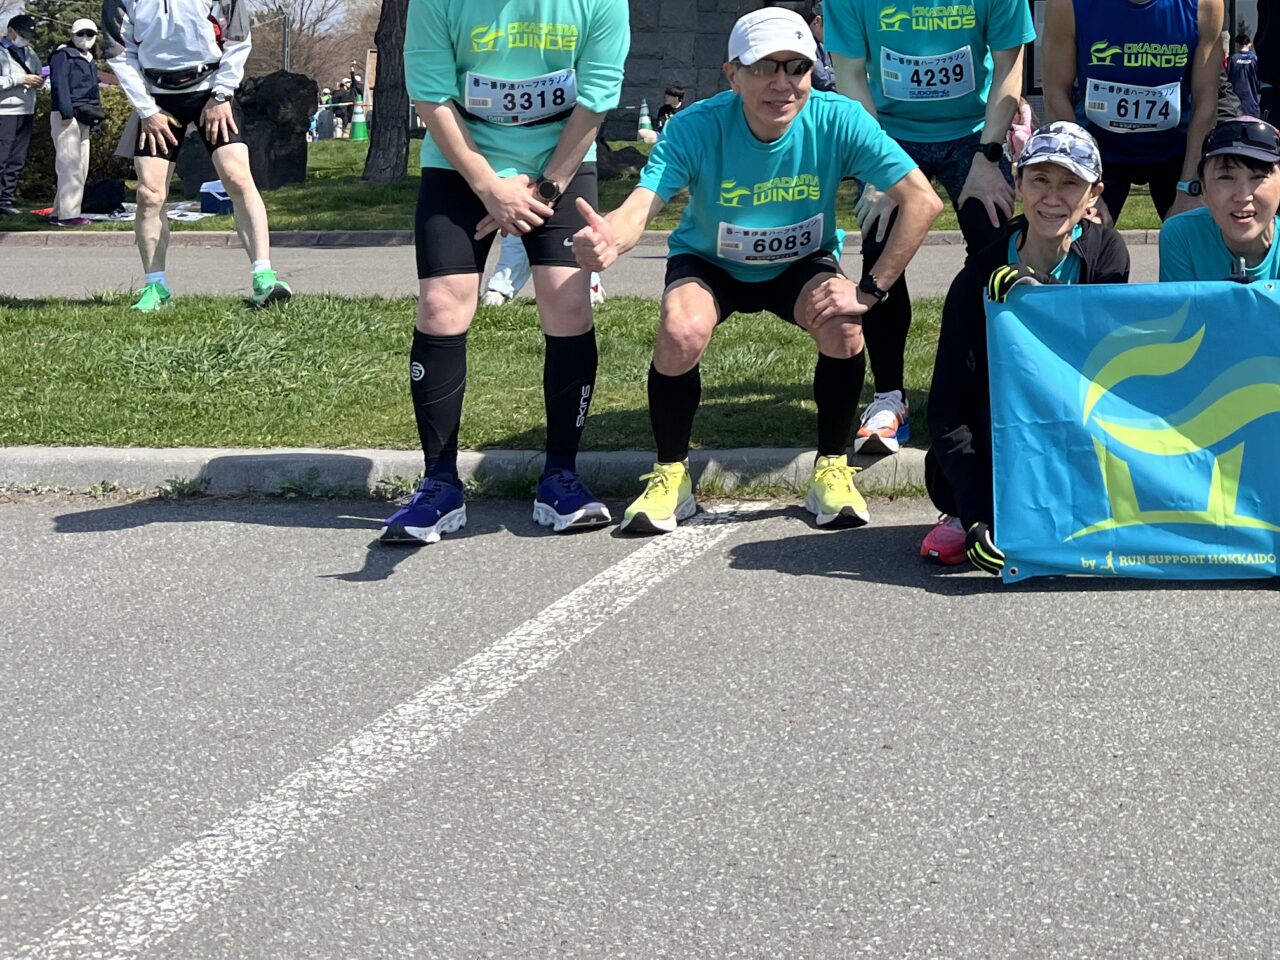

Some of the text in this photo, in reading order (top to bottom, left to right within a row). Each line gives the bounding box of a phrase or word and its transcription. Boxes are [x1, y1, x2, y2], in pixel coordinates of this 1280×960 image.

[912, 15, 976, 31] WINDS
[507, 34, 577, 51] WINDS
[1124, 43, 1188, 54] OKADAMA
[1124, 53, 1188, 68] WINDS
[910, 64, 964, 87] 4239
[503, 87, 566, 111] 3318
[1117, 98, 1170, 120] 6174
[753, 185, 820, 206] WINDS
[753, 231, 812, 253] 6083
[576, 384, 591, 427] SKINS
[1081, 553, 1277, 569] by RUN SUPPORT HOKKAIDO
